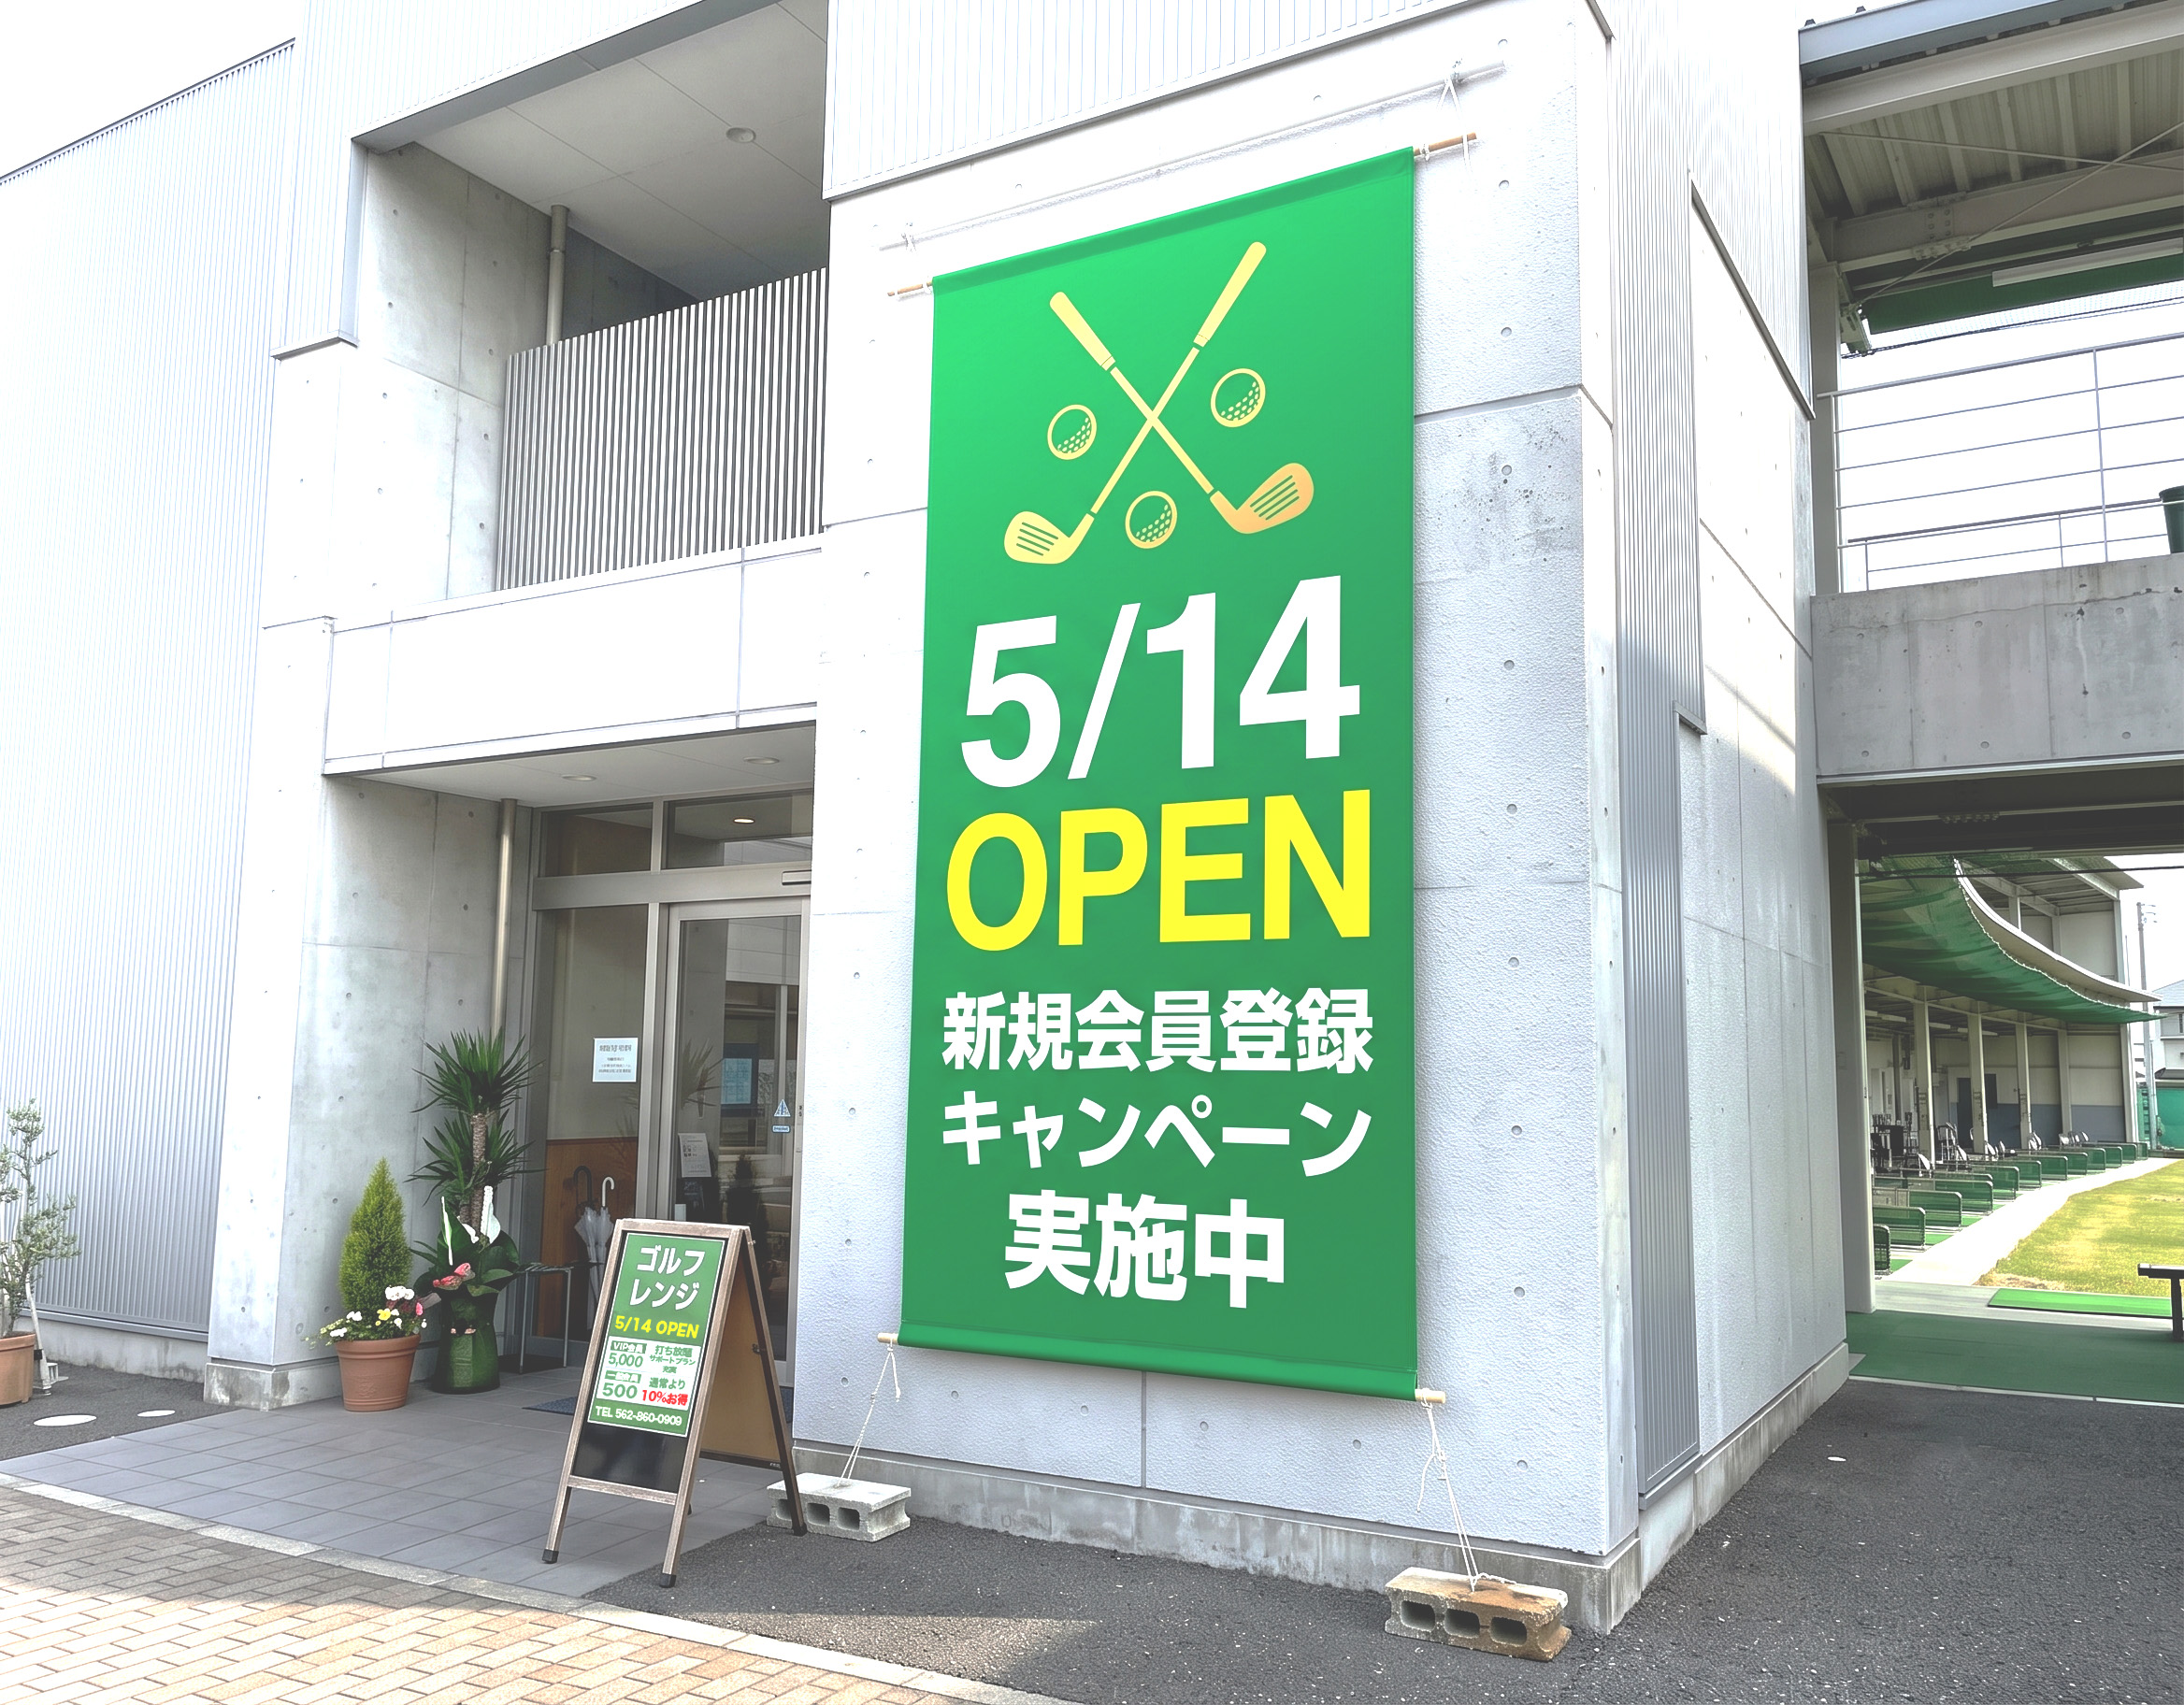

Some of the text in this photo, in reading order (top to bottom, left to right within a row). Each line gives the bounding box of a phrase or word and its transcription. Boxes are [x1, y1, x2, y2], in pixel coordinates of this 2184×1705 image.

[960, 574, 1360, 788] 5/14
[946, 789, 1371, 952] OPEN
[942, 987, 1374, 1074] 新規会員登録
[942, 1090, 1372, 1177] キャンペーン
[637, 1245, 706, 1276] ゴルフ
[1004, 1189, 1285, 1309] 実施中
[630, 1278, 700, 1310] レンジ
[614, 1314, 699, 1339] 5/14 OPEN
[608, 1353, 643, 1368] 5,000
[602, 1383, 638, 1398] 500
[595, 1405, 613, 1418] TEL
